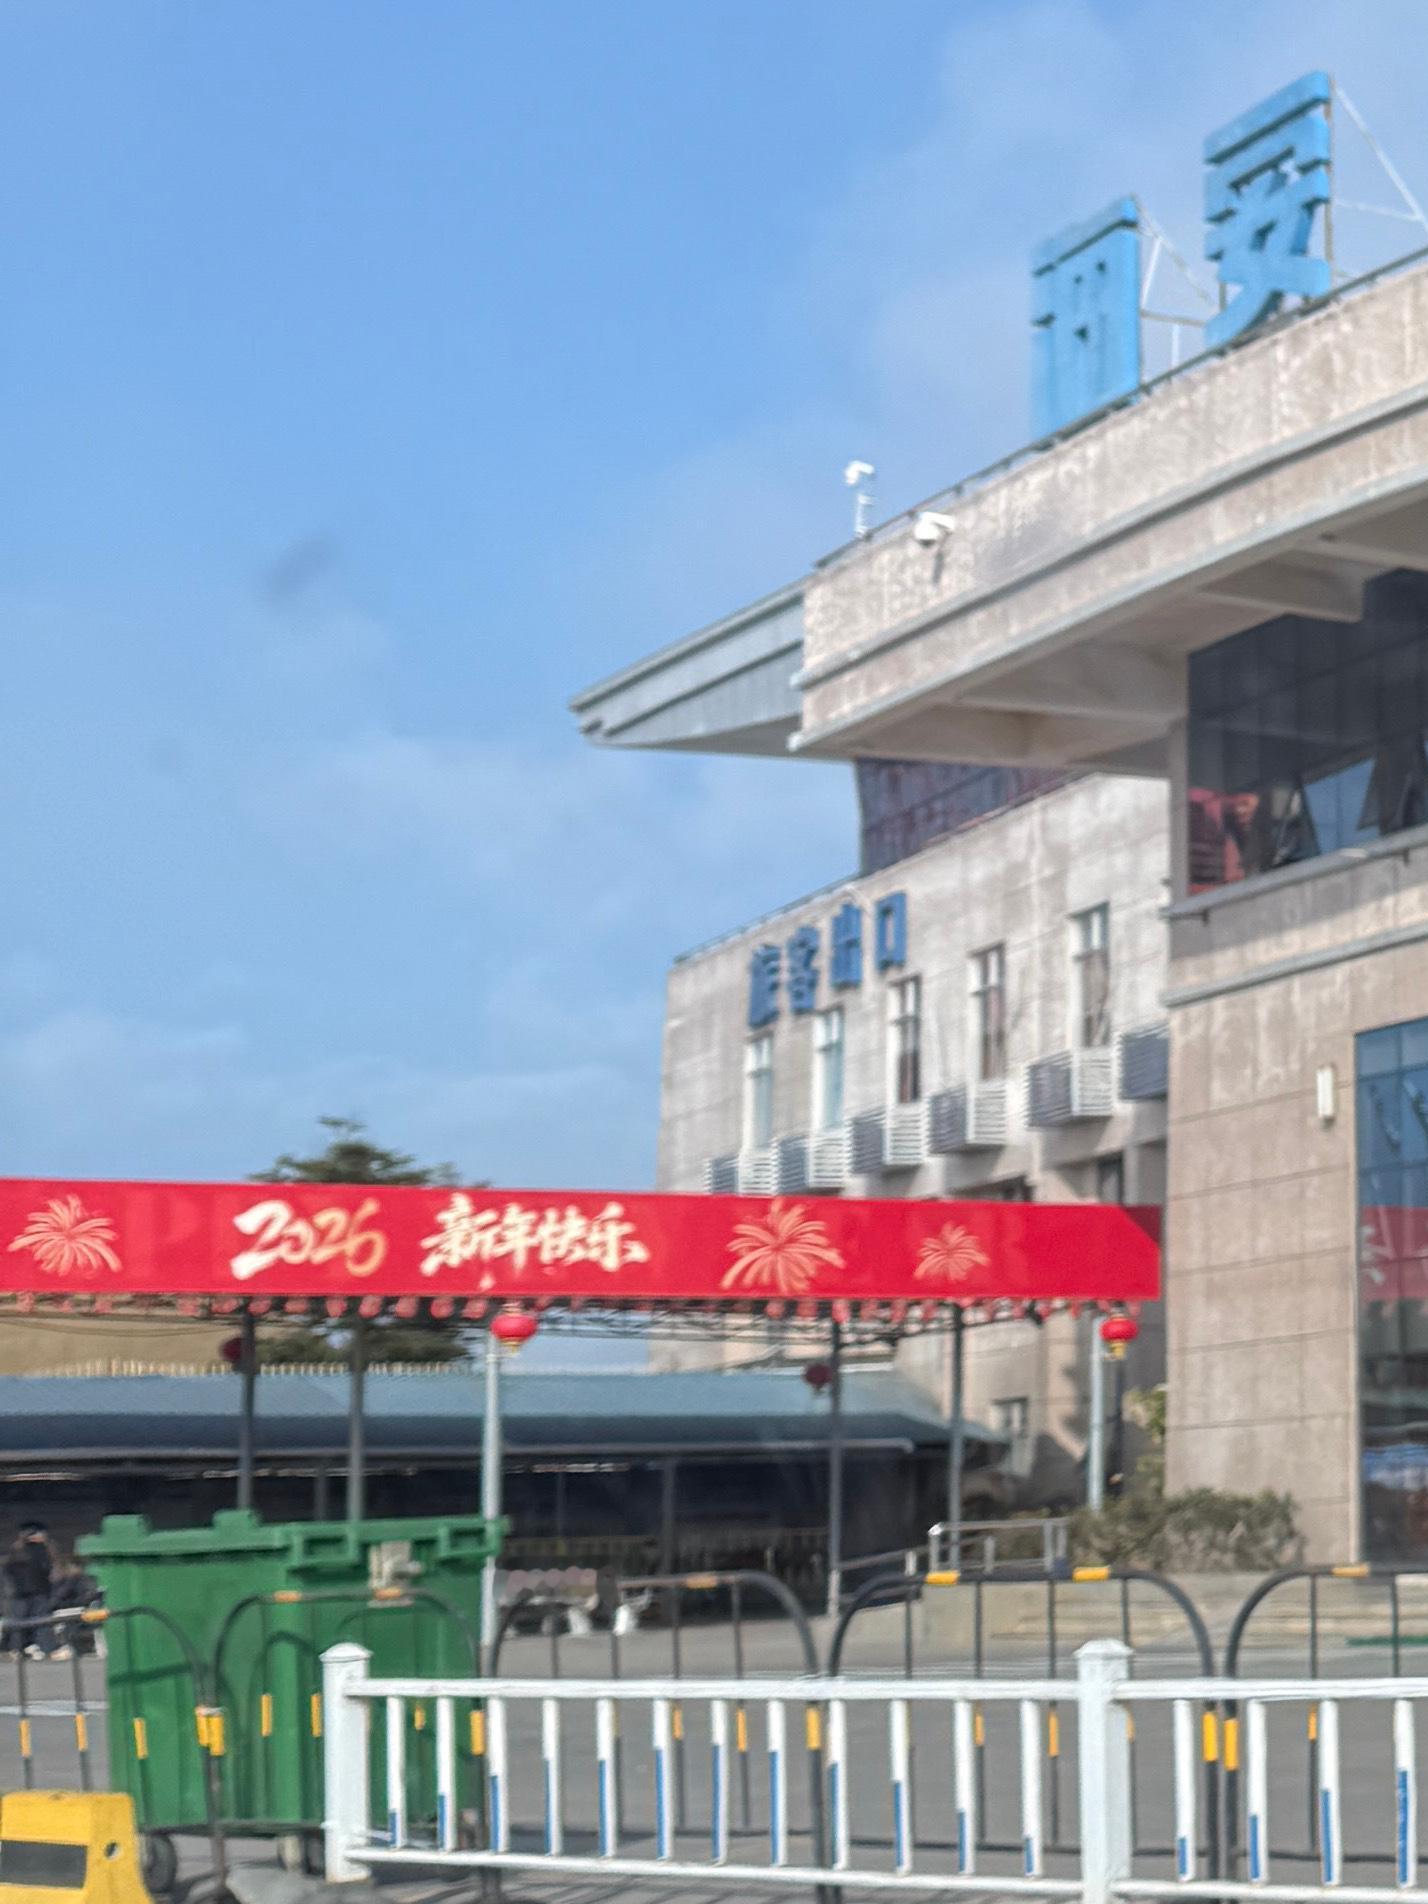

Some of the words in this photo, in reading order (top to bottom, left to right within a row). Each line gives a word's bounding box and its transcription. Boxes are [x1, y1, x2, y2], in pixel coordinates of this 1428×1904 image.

[230, 1199, 387, 1280] 2026
[418, 1192, 650, 1291] 新年快乐
